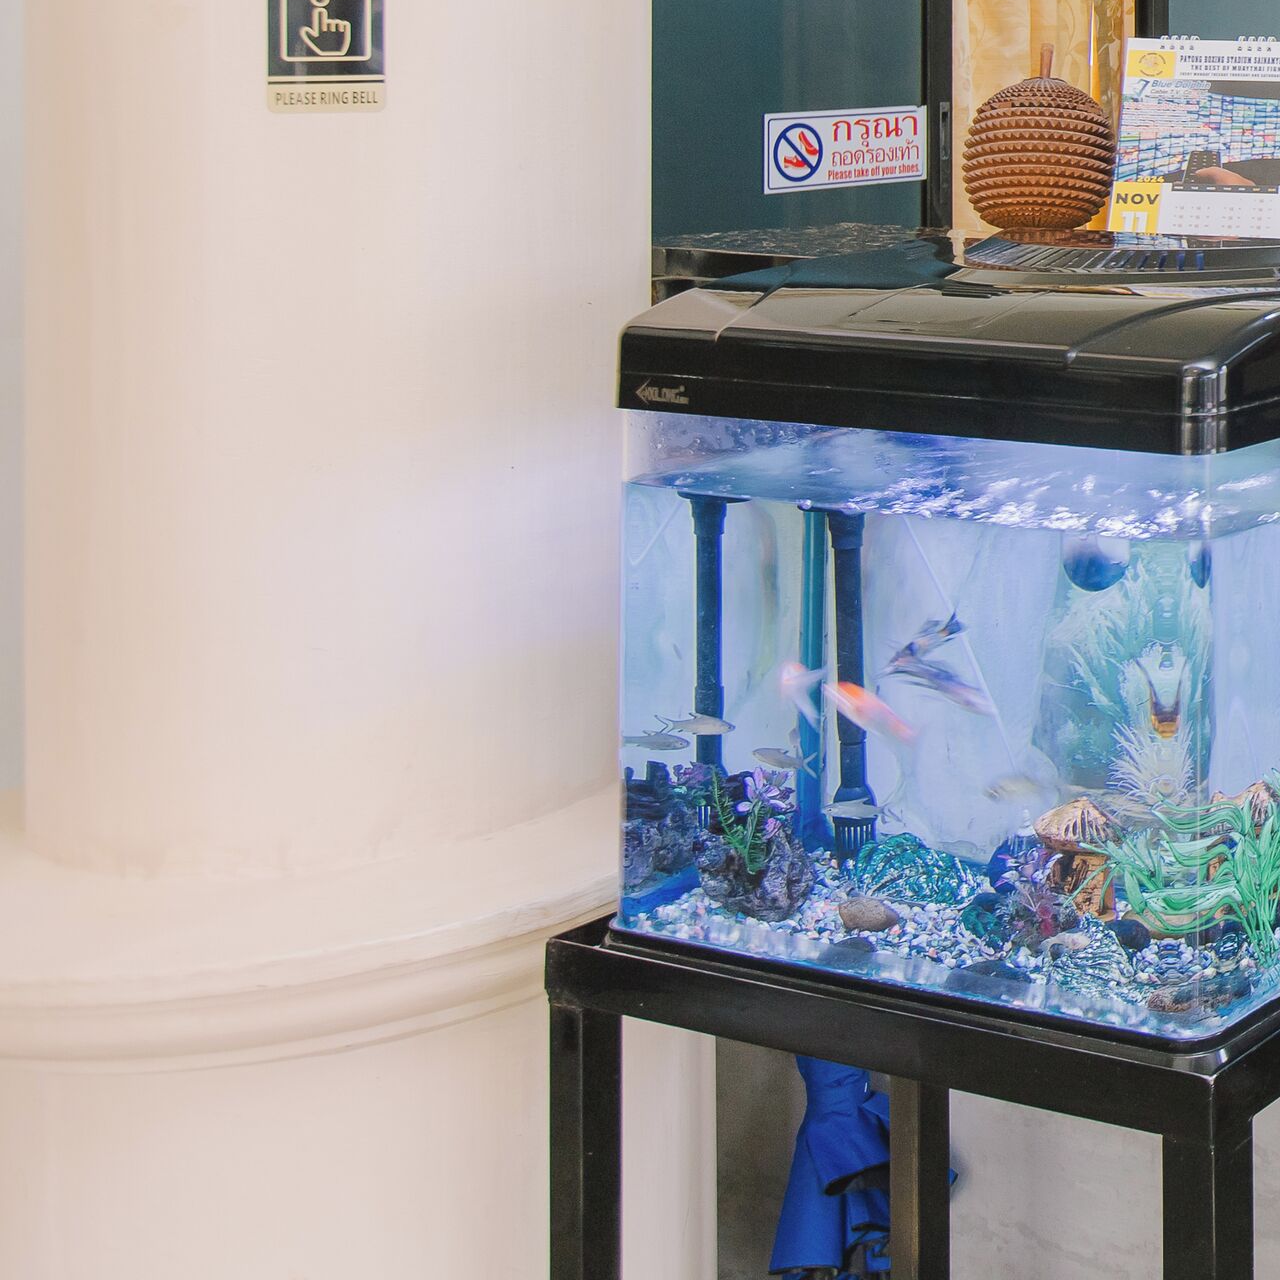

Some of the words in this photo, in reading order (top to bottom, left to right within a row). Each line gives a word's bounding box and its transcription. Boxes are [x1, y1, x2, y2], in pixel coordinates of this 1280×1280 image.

[1226, 56, 1252, 64] STADIUM
[1152, 80, 1172, 88] Blue
[1174, 80, 1211, 89] Dolphin
[275, 92, 317, 106] PLEASE
[320, 91, 350, 104] RING
[352, 91, 379, 104] BELL
[832, 116, 918, 147] กรุณา
[832, 139, 920, 167] ถอดรองเท้า
[828, 170, 852, 181] Please
[854, 168, 870, 178] take
[871, 166, 881, 176] off
[882, 166, 898, 178] your
[1116, 193, 1160, 204] NOV
[1121, 211, 1148, 232] 11
